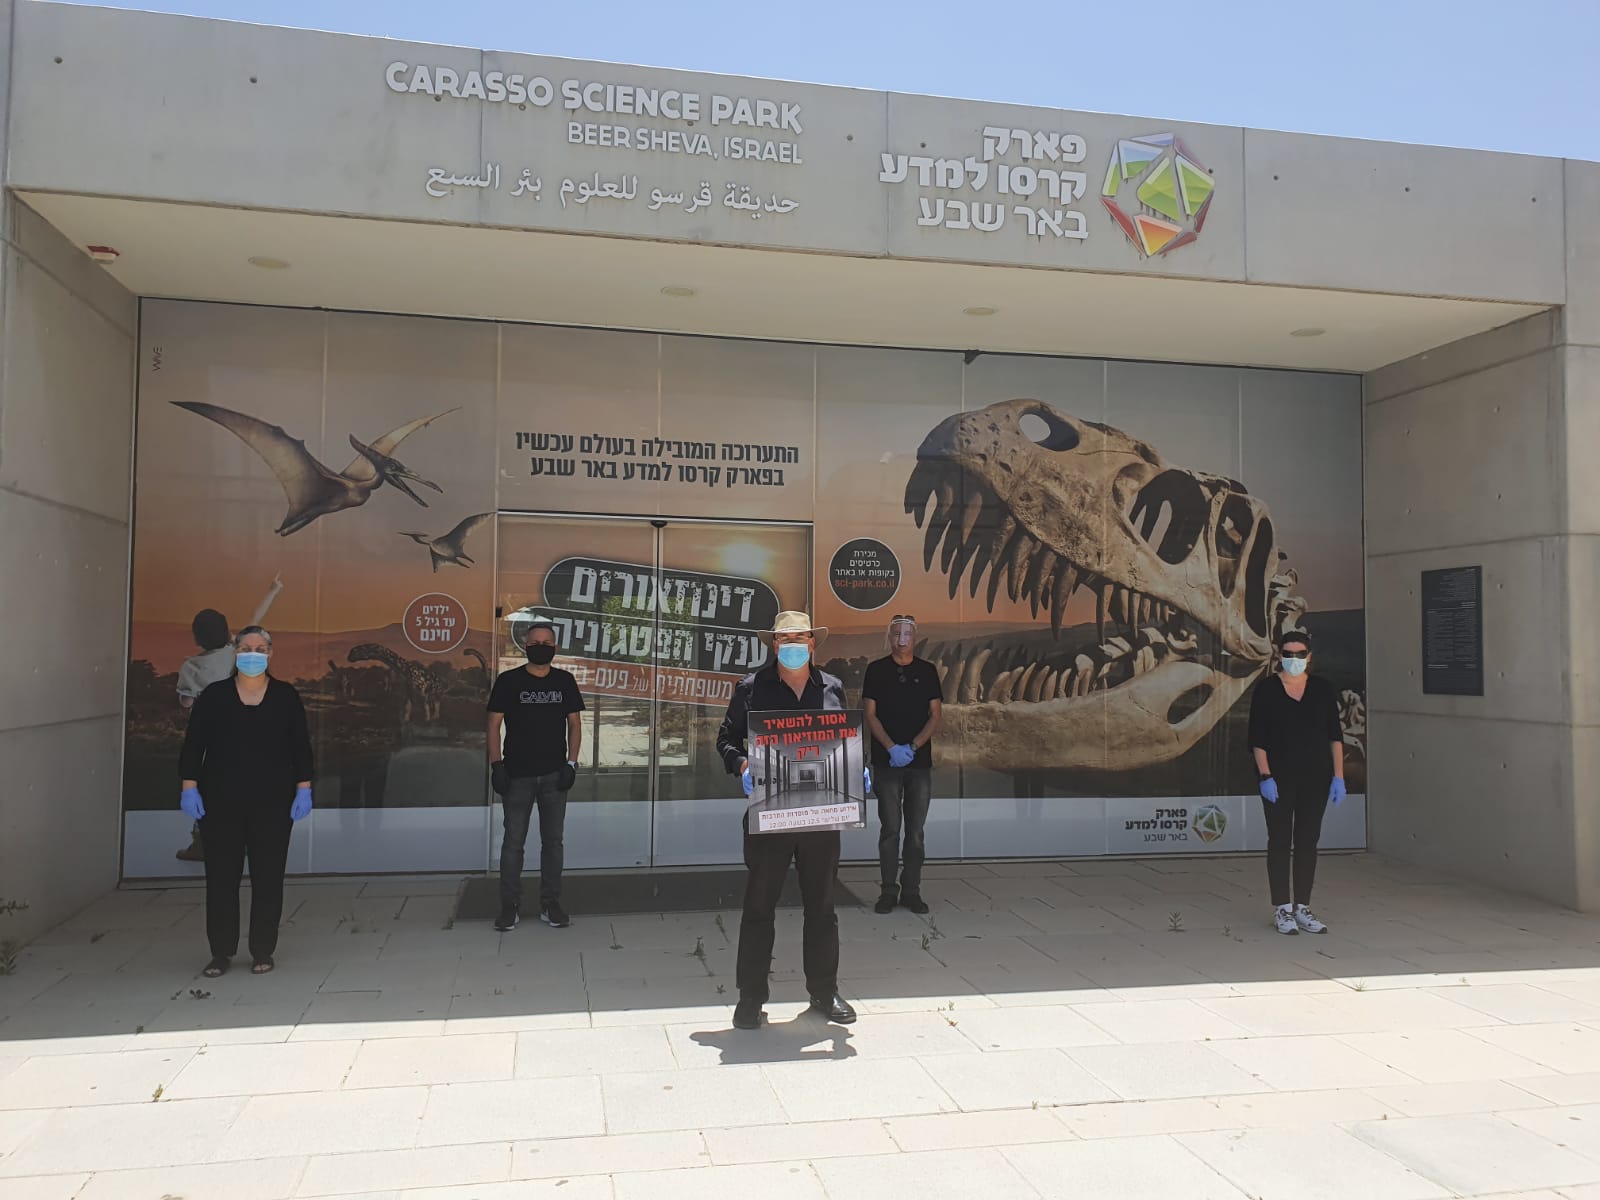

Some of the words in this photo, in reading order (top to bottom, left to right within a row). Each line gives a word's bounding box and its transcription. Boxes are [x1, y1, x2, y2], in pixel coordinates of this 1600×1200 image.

[385, 61, 554, 107] CARASSO
[561, 79, 699, 121] SCIENCE
[711, 95, 803, 134] PARK
[568, 121, 631, 149] BEER
[635, 128, 719, 160] SHEVA,
[724, 136, 803, 165] ISRAEL
[982, 125, 1088, 164] פארק
[425, 163, 499, 197] السبع
[879, 152, 989, 192] למדע
[509, 166, 543, 201] بئر
[559, 171, 639, 209] للعلوم
[997, 164, 1088, 206] קרסו
[647, 181, 713, 212] قرسو
[723, 183, 800, 219] حديقة
[917, 197, 1005, 232] שבע
[1013, 206, 1089, 240] באר
[515, 431, 574, 453] עכשיו
[579, 433, 636, 457] בעולם
[641, 437, 716, 460] המובילה
[722, 443, 799, 464] התערוכה
[530, 456, 575, 477] שבע
[581, 458, 618, 479] באר
[622, 461, 673, 482] למדע
[678, 464, 721, 487] קרסו
[726, 466, 785, 489] בפארק
[854, 550, 877, 558] מכירת
[835, 568, 856, 576] באתר
[868, 569, 895, 578] בקופות
[835, 577, 895, 589] sci-park.co.il
[570, 566, 755, 622] דינוזאורים
[422, 604, 449, 615] ילדים
[415, 616, 422, 627] 5
[424, 616, 440, 627] גיל
[442, 617, 456, 627] עד
[420, 629, 451, 642] חינם
[552, 617, 694, 661] הפטגוניה
[704, 631, 768, 671] ענקי
[594, 667, 629, 690] פעם
[520, 691, 563, 704] CALVIN
[763, 714, 813, 730] להשאיר
[817, 713, 847, 726] אסור
[755, 734, 779, 746] הזה
[783, 729, 835, 746] המוזיאון
[839, 727, 858, 739] את
[797, 745, 819, 760] ריק
[1125, 819, 1158, 830] למדע
[1155, 808, 1187, 820] פארק
[1160, 820, 1188, 831] קרסו
[1144, 833, 1166, 842] שבע
[1168, 832, 1188, 841] באר
